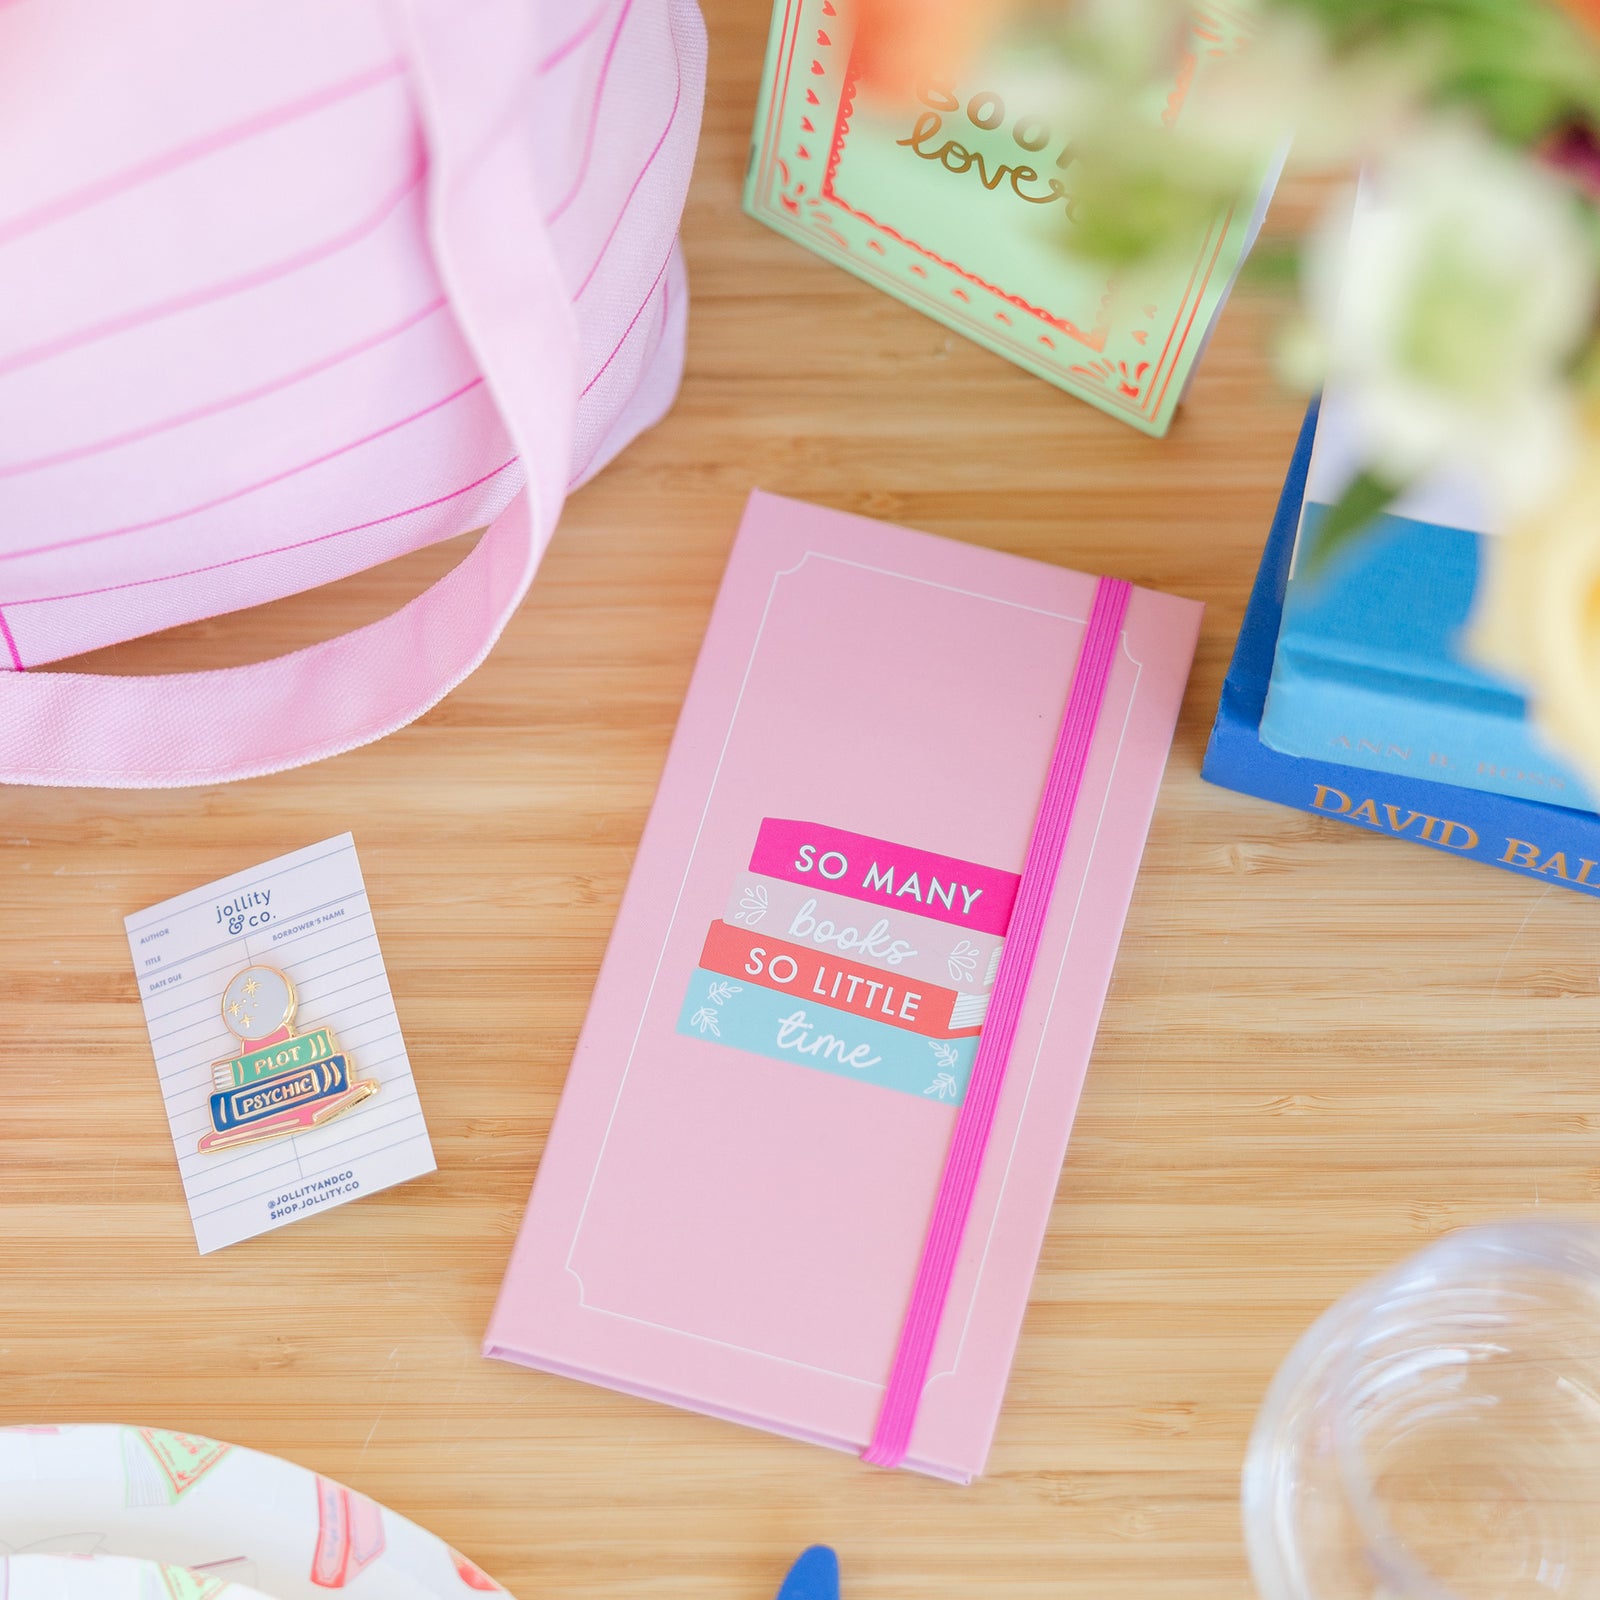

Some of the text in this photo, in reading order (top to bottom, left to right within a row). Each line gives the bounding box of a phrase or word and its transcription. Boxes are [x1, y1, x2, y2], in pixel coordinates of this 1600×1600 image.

[1309, 784, 1479, 850] DAVID
[795, 844, 983, 914] SO MANY
[216, 889, 272, 923] jollity
[228, 914, 246, 936] &
[272, 908, 346, 942] BORROWER'S NAME
[140, 927, 170, 945] AUTHOR
[788, 898, 918, 966] books
[144, 955, 162, 967] TITLE
[149, 972, 183, 992] DATE DUE
[744, 947, 922, 1021] SO LITTLE
[776, 1010, 882, 1069] time
[254, 1045, 301, 1075] PLOT
[243, 1076, 313, 1114] PSYCHIC
[268, 1170, 354, 1209] @JOLLITYANDCO
[270, 1181, 360, 1220] SHOP.JOLLITY.CO
